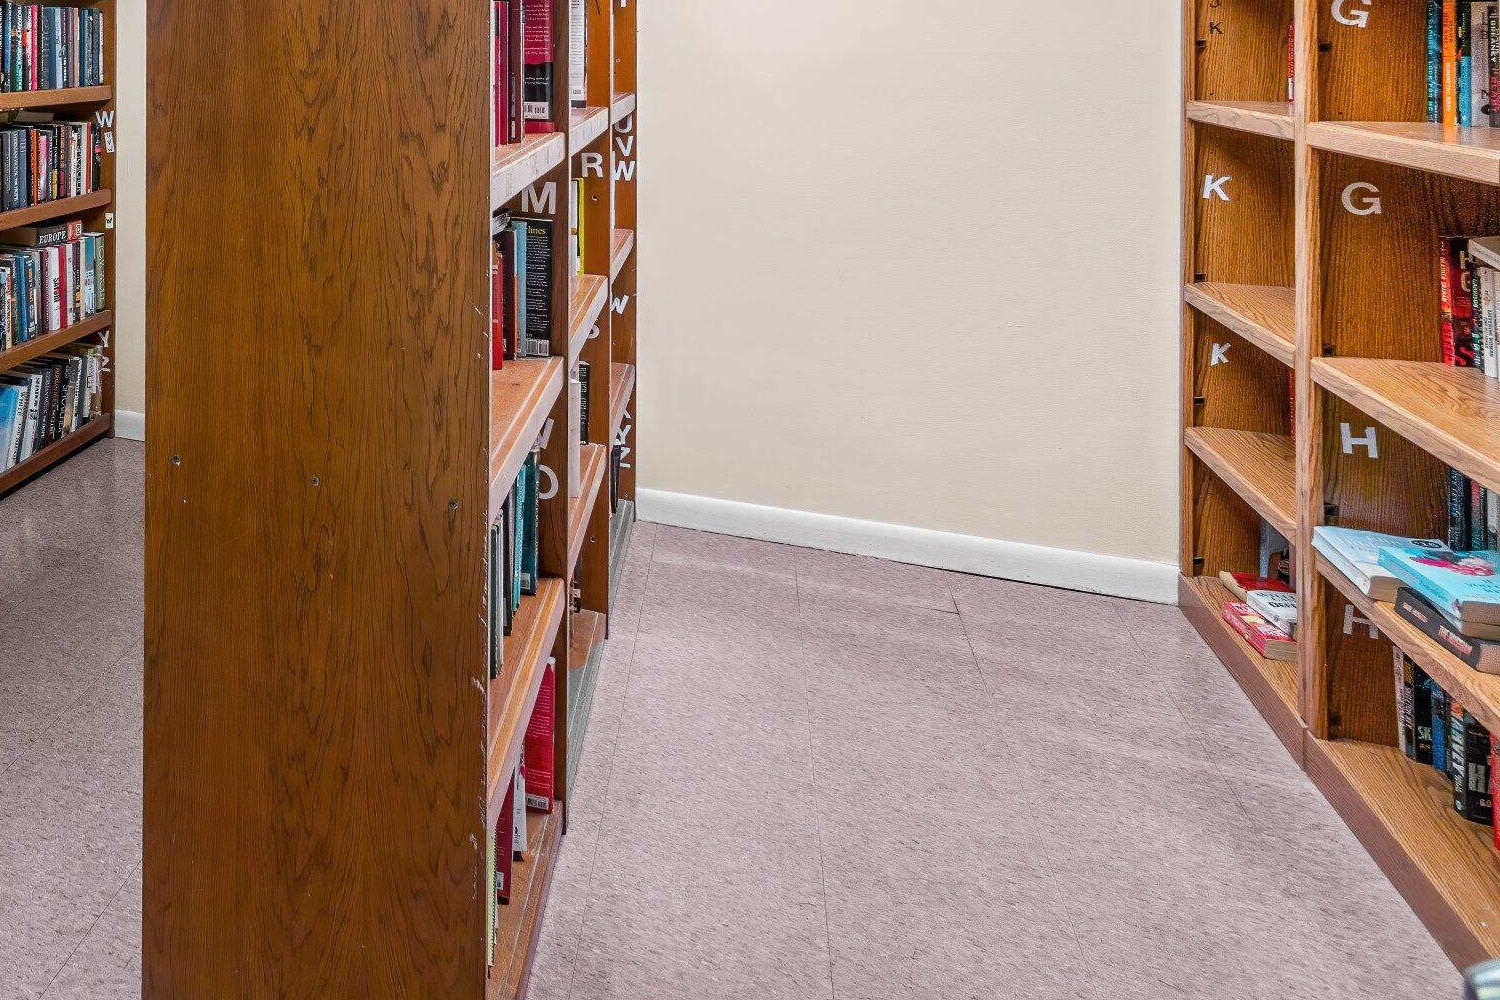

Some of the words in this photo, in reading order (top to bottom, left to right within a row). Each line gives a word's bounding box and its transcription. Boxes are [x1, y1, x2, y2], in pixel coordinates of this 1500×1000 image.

[95, 111, 115, 128] W
[616, 137, 634, 157] V
[582, 153, 604, 178] R
[611, 160, 636, 181] W
[522, 181, 556, 214] M
[1203, 174, 1233, 201] K
[1341, 181, 1382, 216] G
[39, 230, 67, 245] EUROPE
[97, 330, 109, 348] Y
[1211, 342, 1232, 367] K
[1340, 422, 1379, 458] H
[1343, 604, 1379, 640] H
